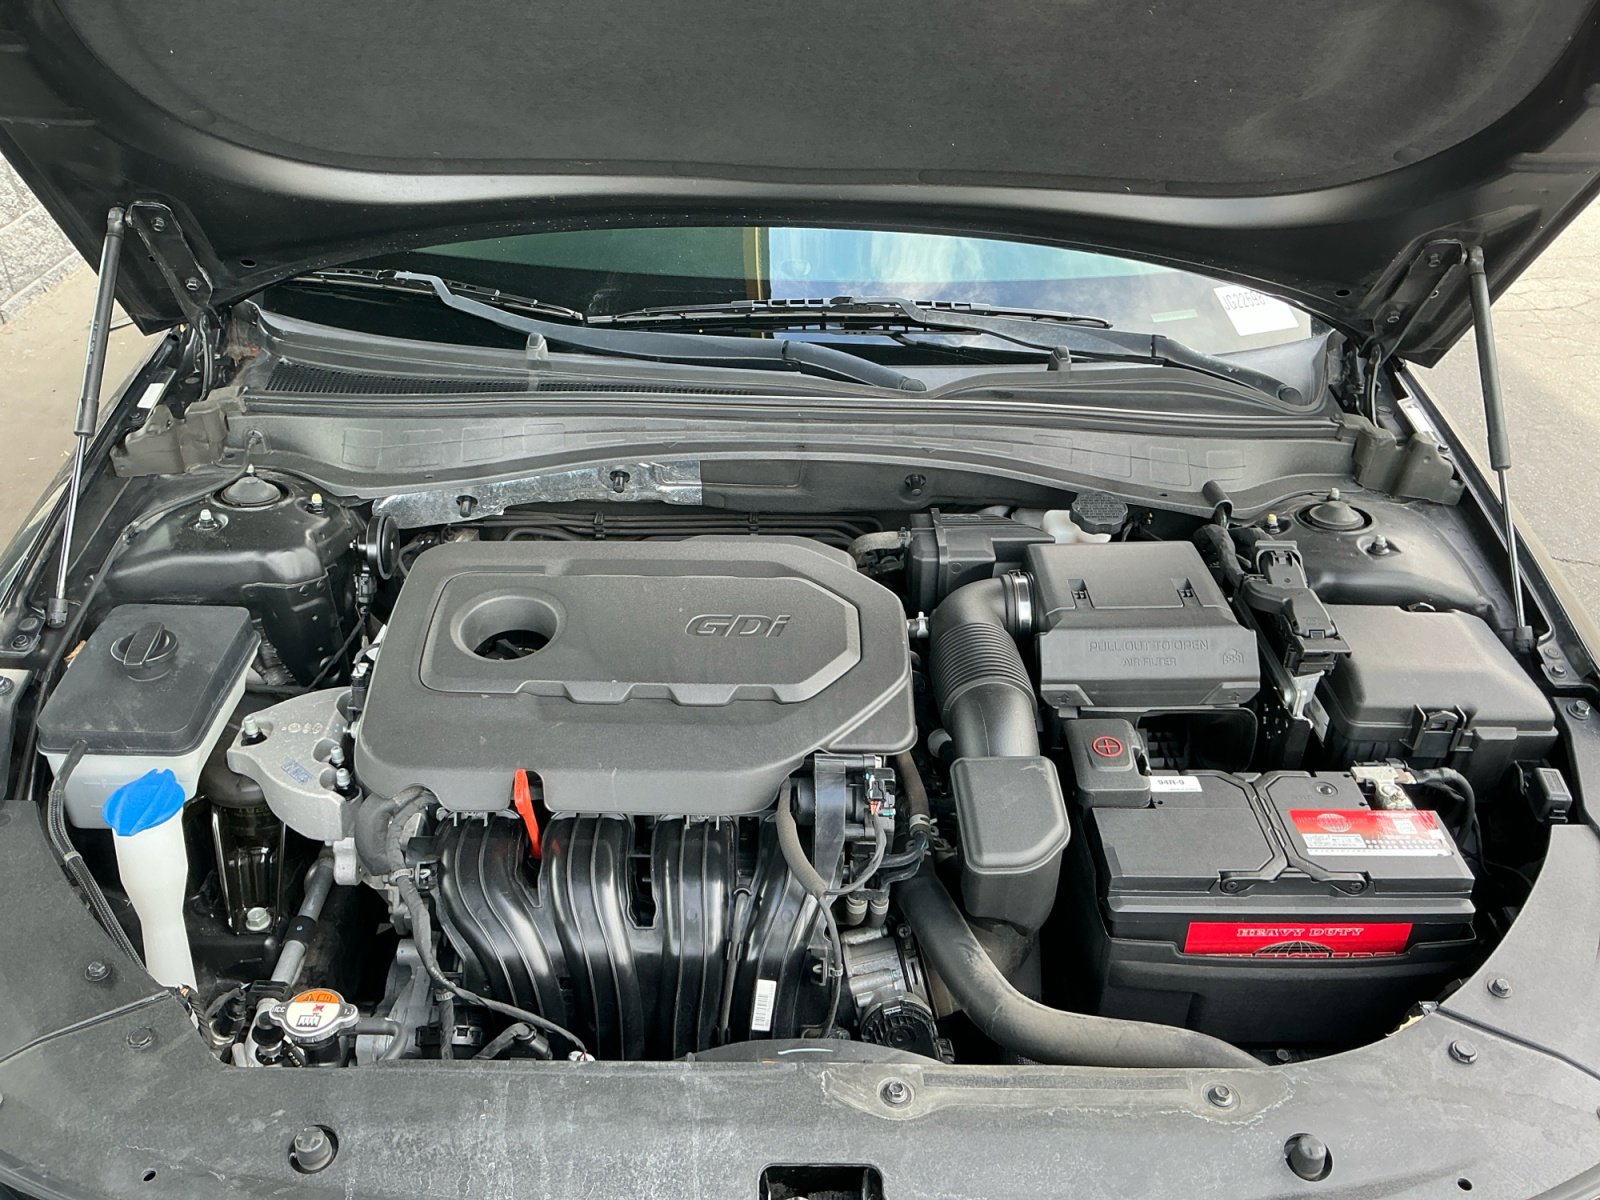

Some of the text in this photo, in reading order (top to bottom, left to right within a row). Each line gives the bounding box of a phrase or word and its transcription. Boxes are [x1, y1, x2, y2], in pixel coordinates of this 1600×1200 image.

[684, 614, 791, 637] GDi
[1089, 639, 1209, 651] PULL OUT TO OPEN
[1123, 657, 1177, 667] AIR FILTER
[1236, 928, 1364, 937] HEAVY DUTY
